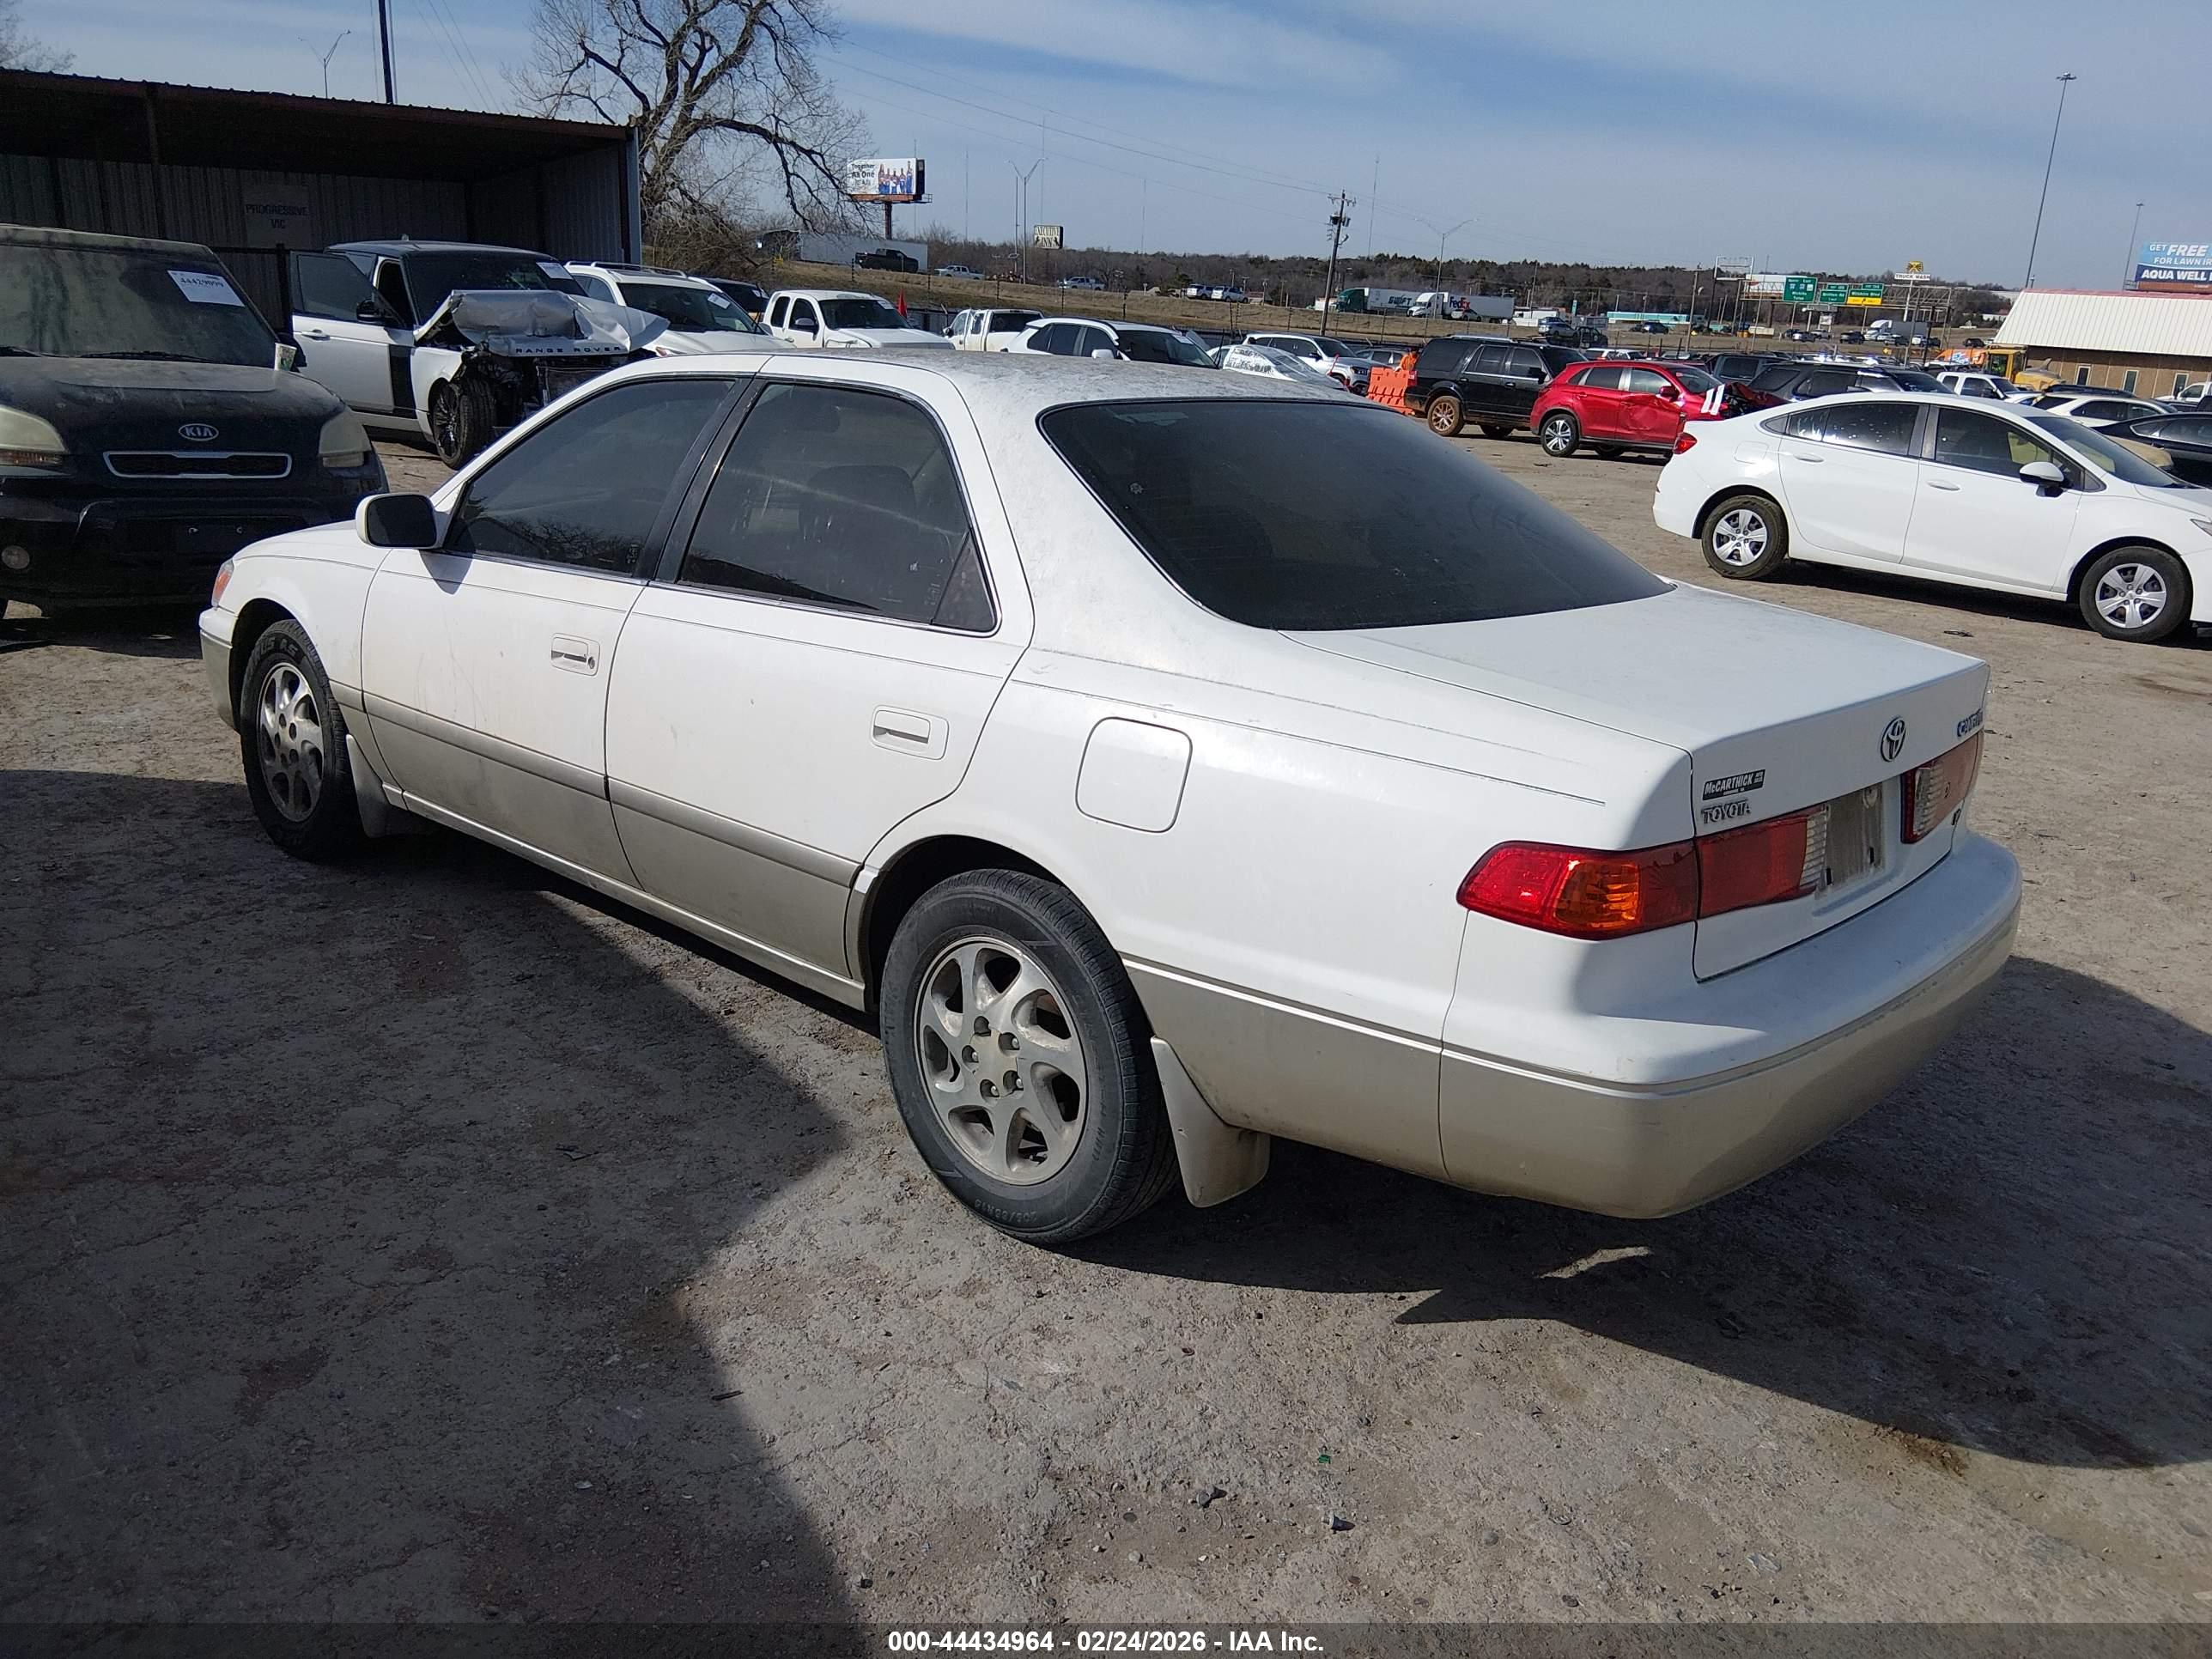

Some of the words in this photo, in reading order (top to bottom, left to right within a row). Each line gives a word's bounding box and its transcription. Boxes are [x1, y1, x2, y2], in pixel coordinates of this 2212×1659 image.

[246, 204, 308, 216] PROGRESSIVE
[1034, 226, 1059, 236] EXECUTIVE
[1041, 237, 1054, 247] INN
[2166, 244, 2209, 257] FREE
[2141, 269, 2175, 280] AQUA
[2177, 270, 2208, 282] WELL
[1389, 294, 1413, 306] SWIFT
[1449, 296, 1471, 309] FedEx
[185, 426, 213, 436] KIA
[1701, 799, 1752, 824] TOYOTA
